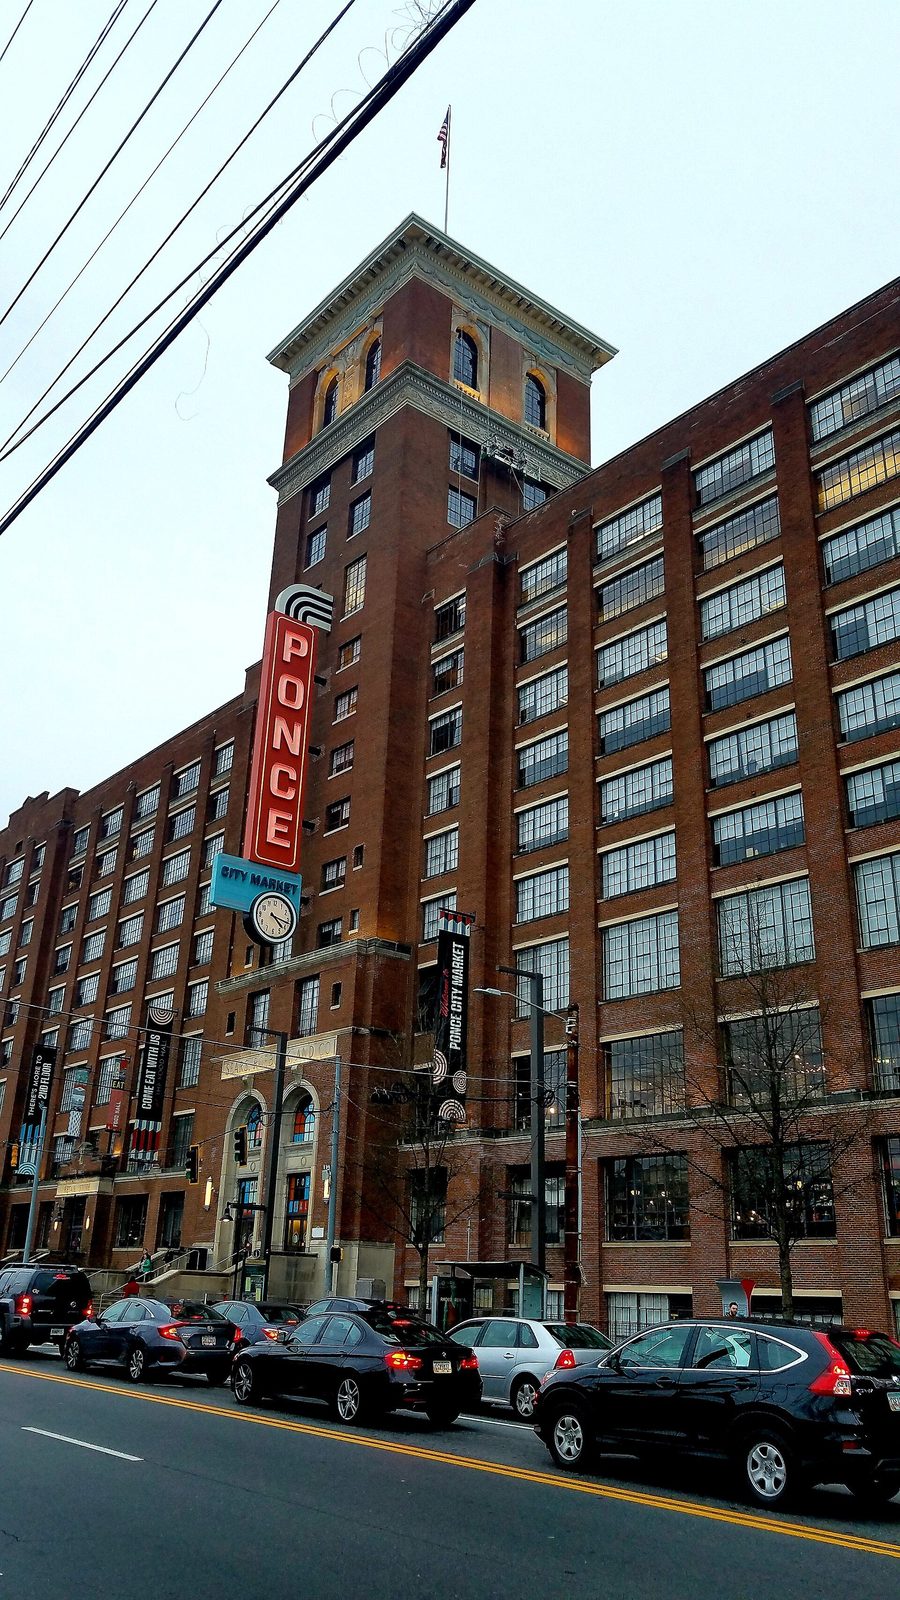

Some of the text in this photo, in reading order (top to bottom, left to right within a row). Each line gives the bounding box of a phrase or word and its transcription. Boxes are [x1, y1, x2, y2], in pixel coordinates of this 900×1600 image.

[266, 630, 308, 848] PONCE
[221, 866, 298, 894] CITY MARKET
[450, 941, 464, 1050] PONCE CITY MARKET
[28, 1055, 42, 1116] THERE'S MORE TO
[38, 1063, 52, 1099] 2ND FLOOR
[113, 1080, 124, 1089] EAT
[142, 1034, 160, 1110] COME EAT WITH US
